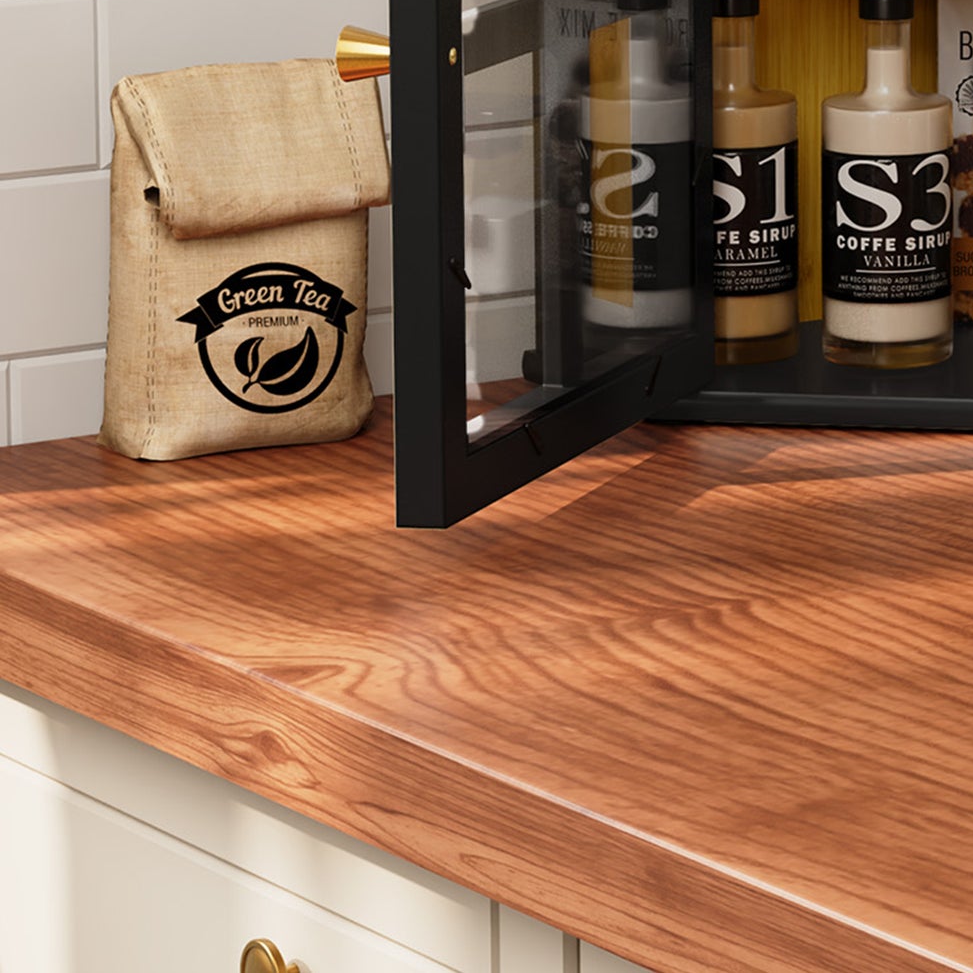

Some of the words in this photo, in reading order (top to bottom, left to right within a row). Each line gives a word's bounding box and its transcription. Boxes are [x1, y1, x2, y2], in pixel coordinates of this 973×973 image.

[712, 146, 794, 225] S1
[836, 153, 951, 232] S3
[716, 230, 740, 245] FE
[748, 224, 796, 244] SIRUP
[836, 234, 897, 252] COFFE
[904, 231, 951, 251] SIRUP
[714, 245, 779, 261] ARAMEL
[863, 253, 931, 268] VANILLA
[850, 275, 893, 284] RECOMMEND
[894, 276, 910, 284] ADD
[217, 284, 285, 314] Green
[292, 279, 332, 312] Tea
[248, 315, 299, 328] PREMIUM
